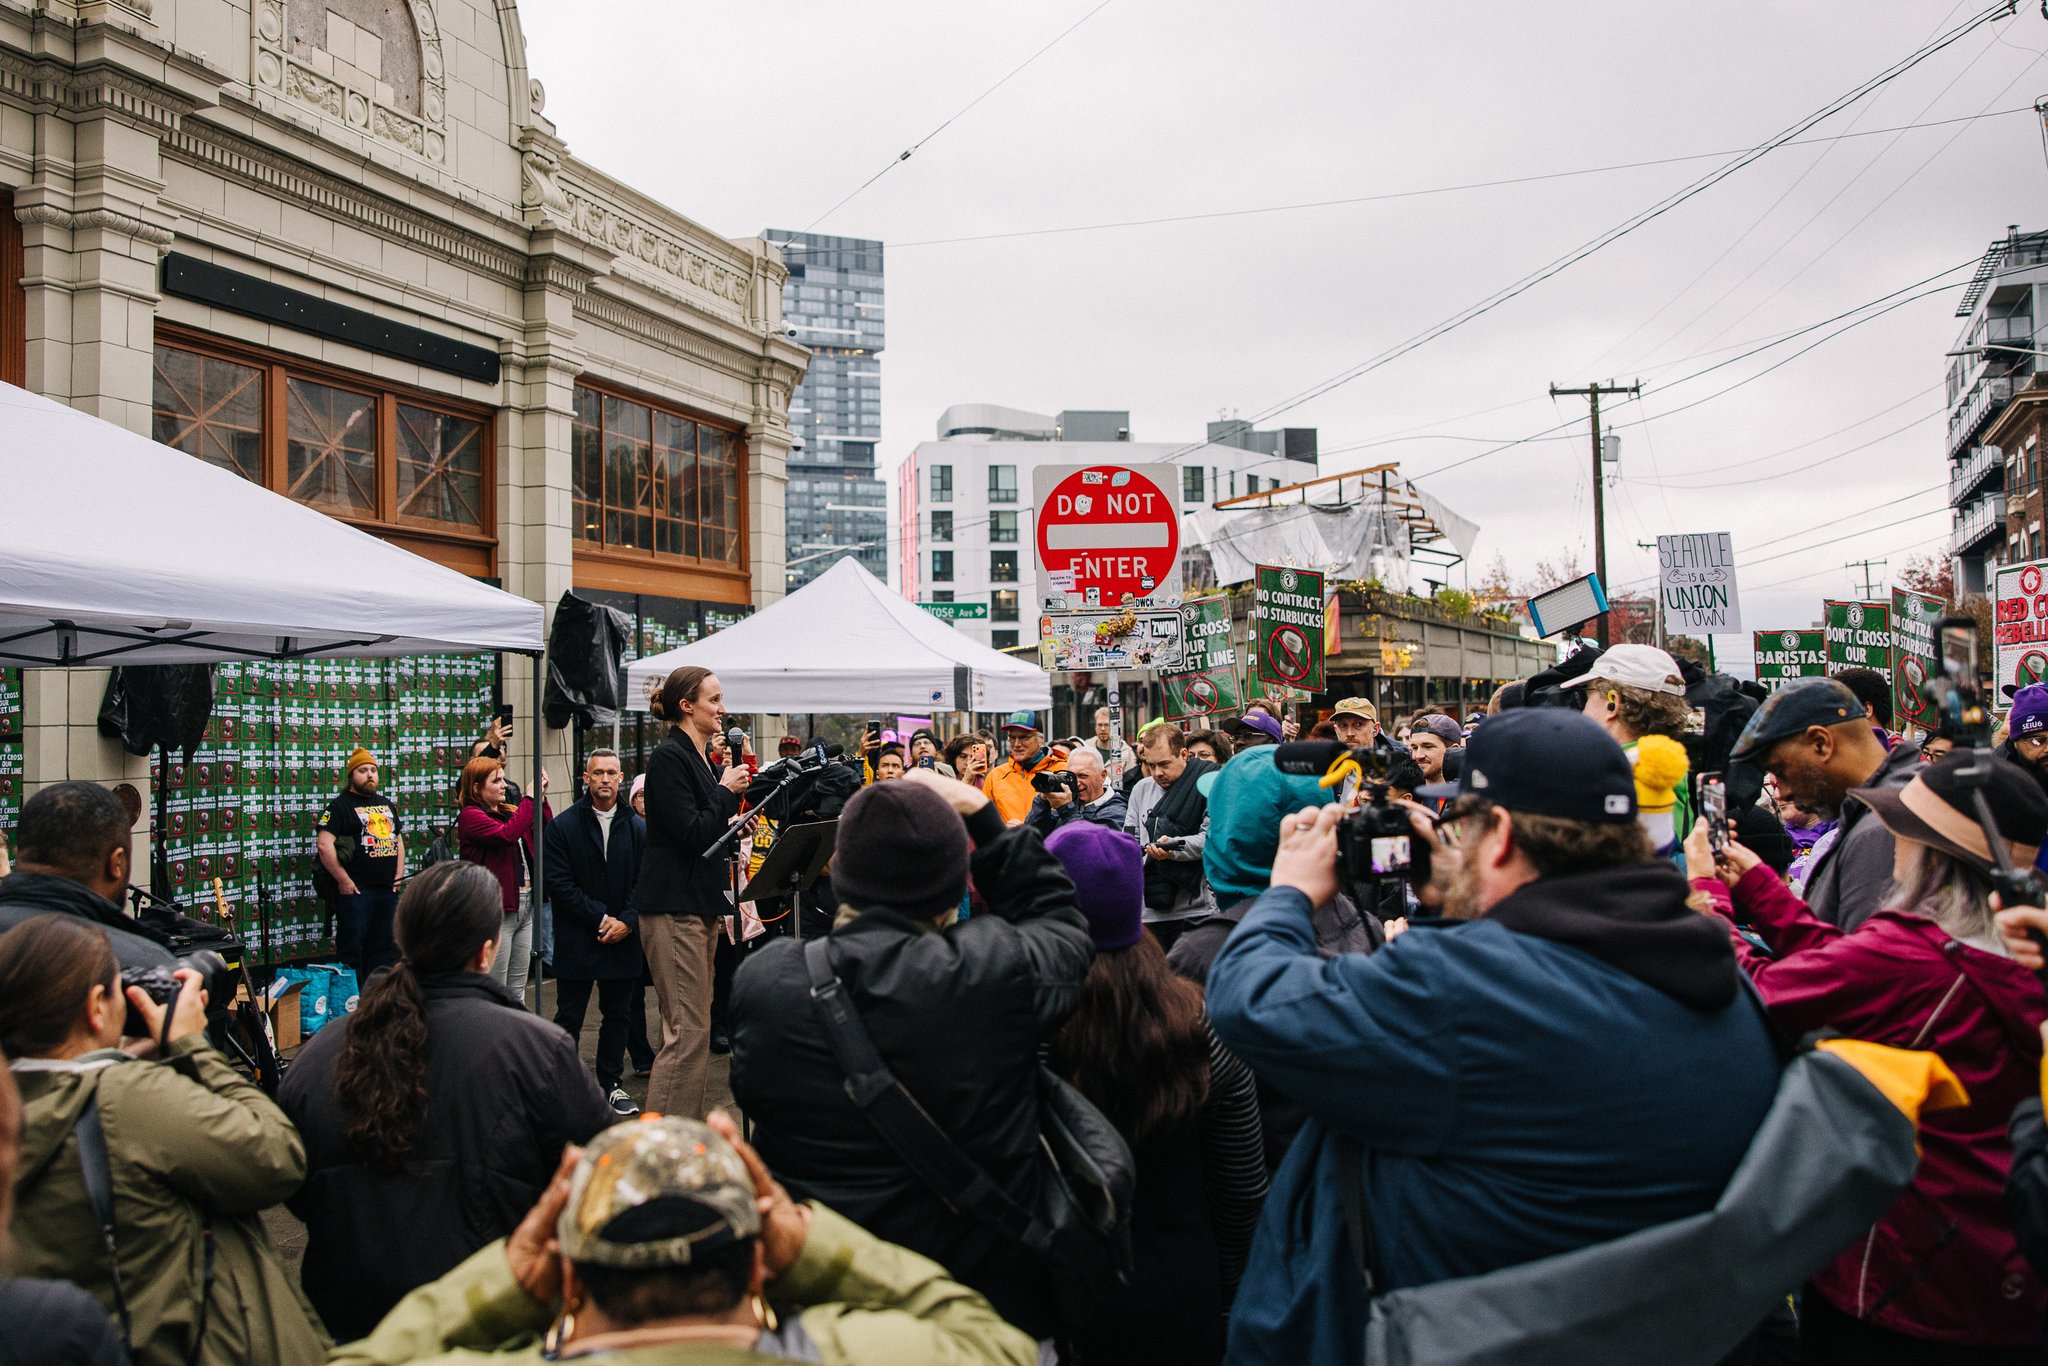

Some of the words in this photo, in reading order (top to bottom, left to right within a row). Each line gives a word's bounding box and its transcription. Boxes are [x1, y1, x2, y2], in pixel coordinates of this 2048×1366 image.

[1107, 493, 1155, 515] NOT
[1658, 534, 1732, 568] SEATTLE
[1070, 557, 1148, 579] ENTER
[1256, 589, 1268, 602] NO
[1272, 592, 1324, 613] CONTRACT,
[1666, 585, 1728, 609] UNION
[959, 608, 974, 617] Ave
[1256, 605, 1268, 618] NO
[1271, 608, 1324, 628] STARBUCKS!
[1680, 609, 1725, 627] TOWN
[1997, 597, 2028, 623] RED
[1192, 619, 1231, 638] CROSS
[1826, 626, 1854, 643] DON'T
[1856, 630, 1890, 648] CROSS
[1206, 649, 1236, 668] LINE
[1756, 650, 1826, 664] BARISTAS
[1846, 646, 1866, 663] OUR
[1782, 665, 1800, 676] ON
